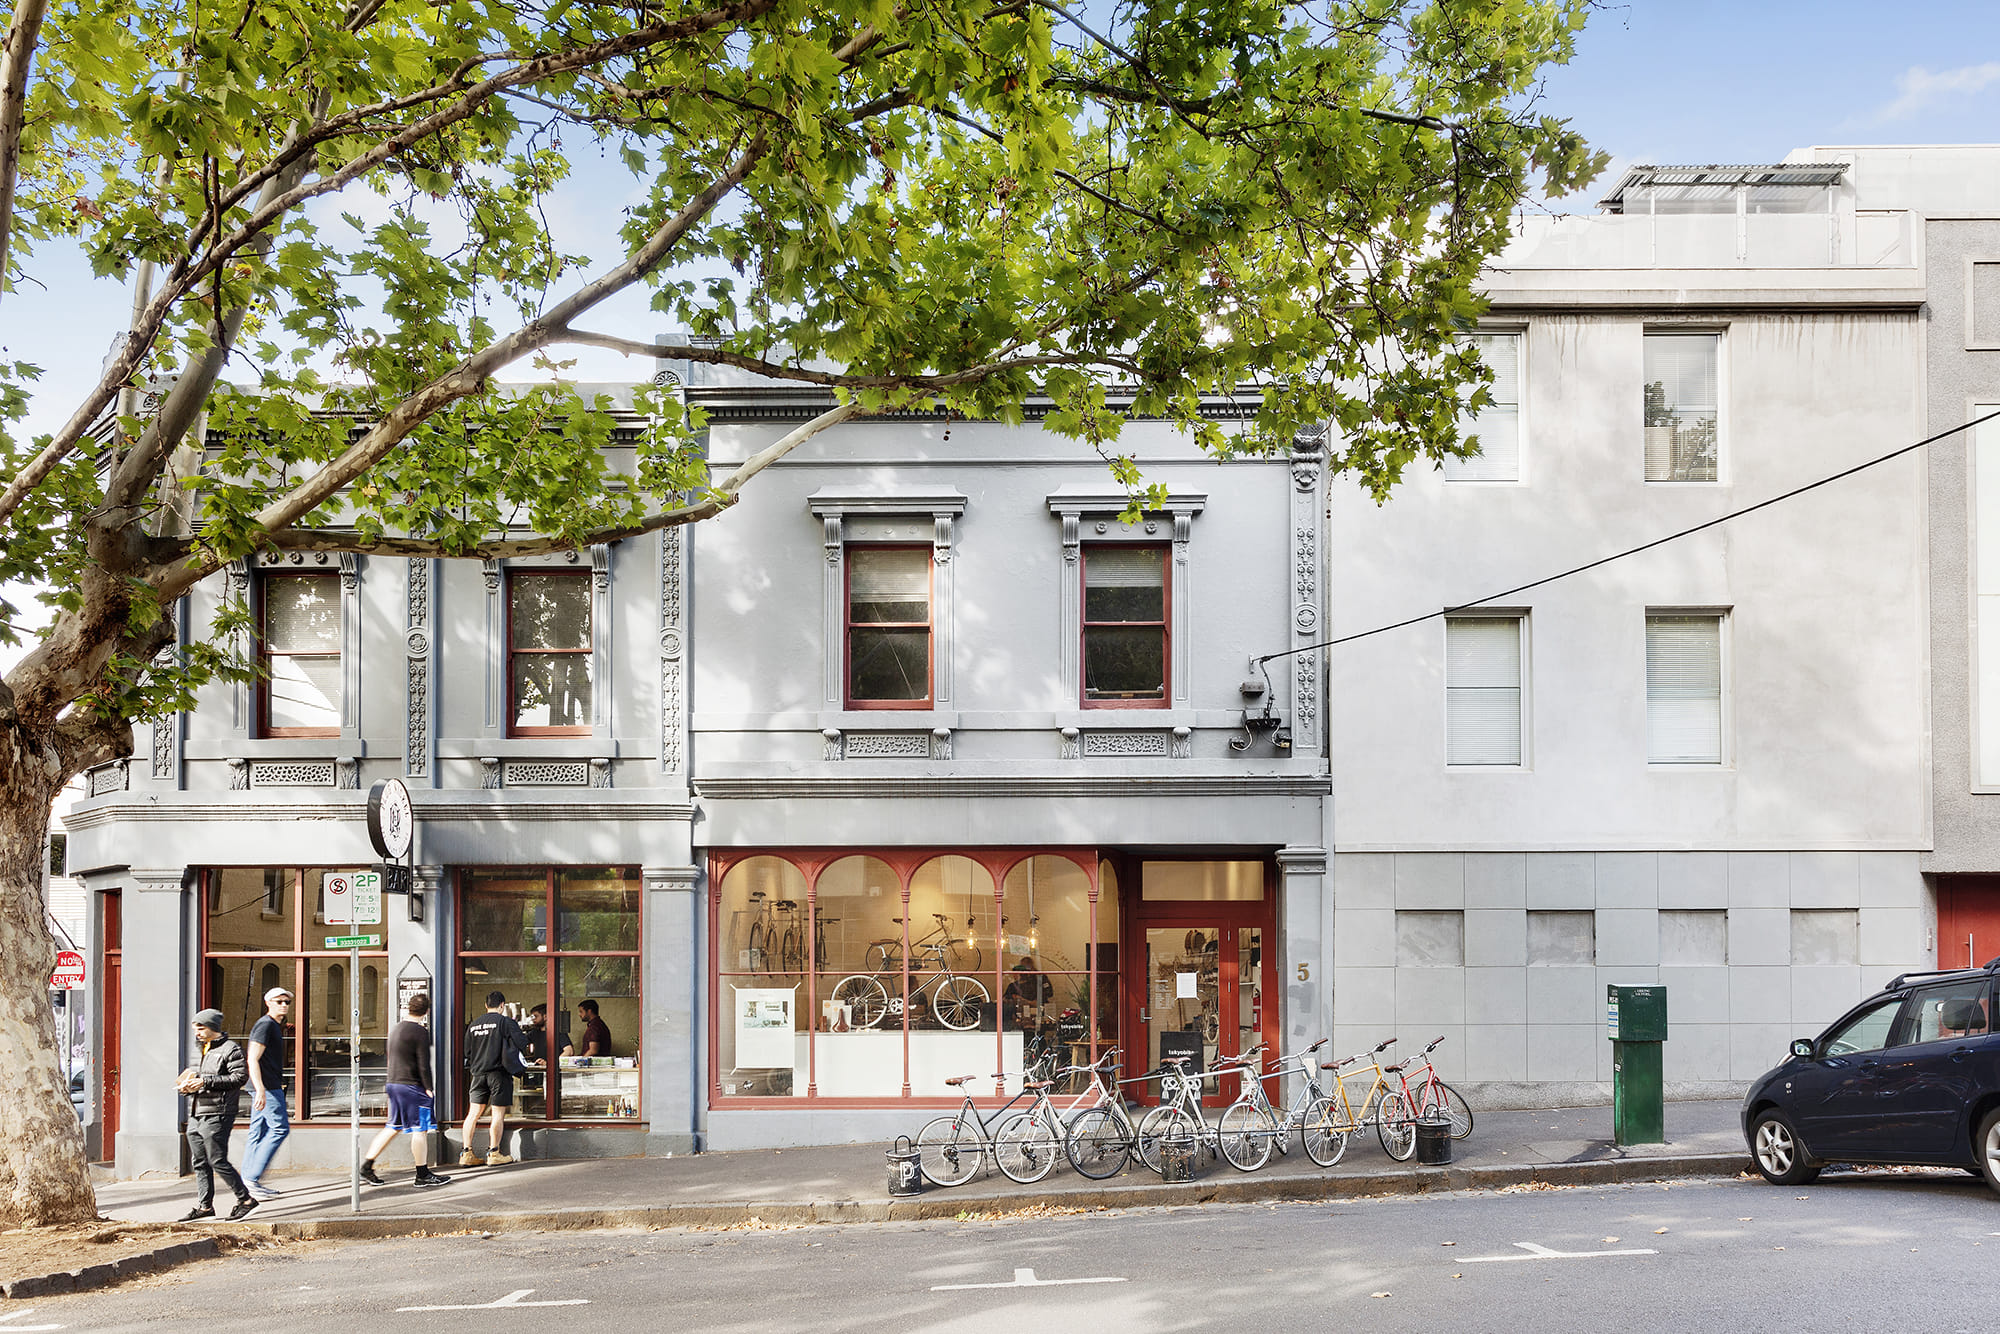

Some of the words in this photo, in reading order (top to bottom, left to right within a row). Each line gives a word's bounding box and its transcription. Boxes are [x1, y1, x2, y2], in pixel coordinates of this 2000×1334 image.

[355, 875, 378, 887] 2P
[388, 868, 407, 889] BAR
[61, 957, 73, 966] NO
[53, 975, 81, 983] ENTRY
[1297, 963, 1310, 981] 5
[900, 1162, 915, 1188] P
